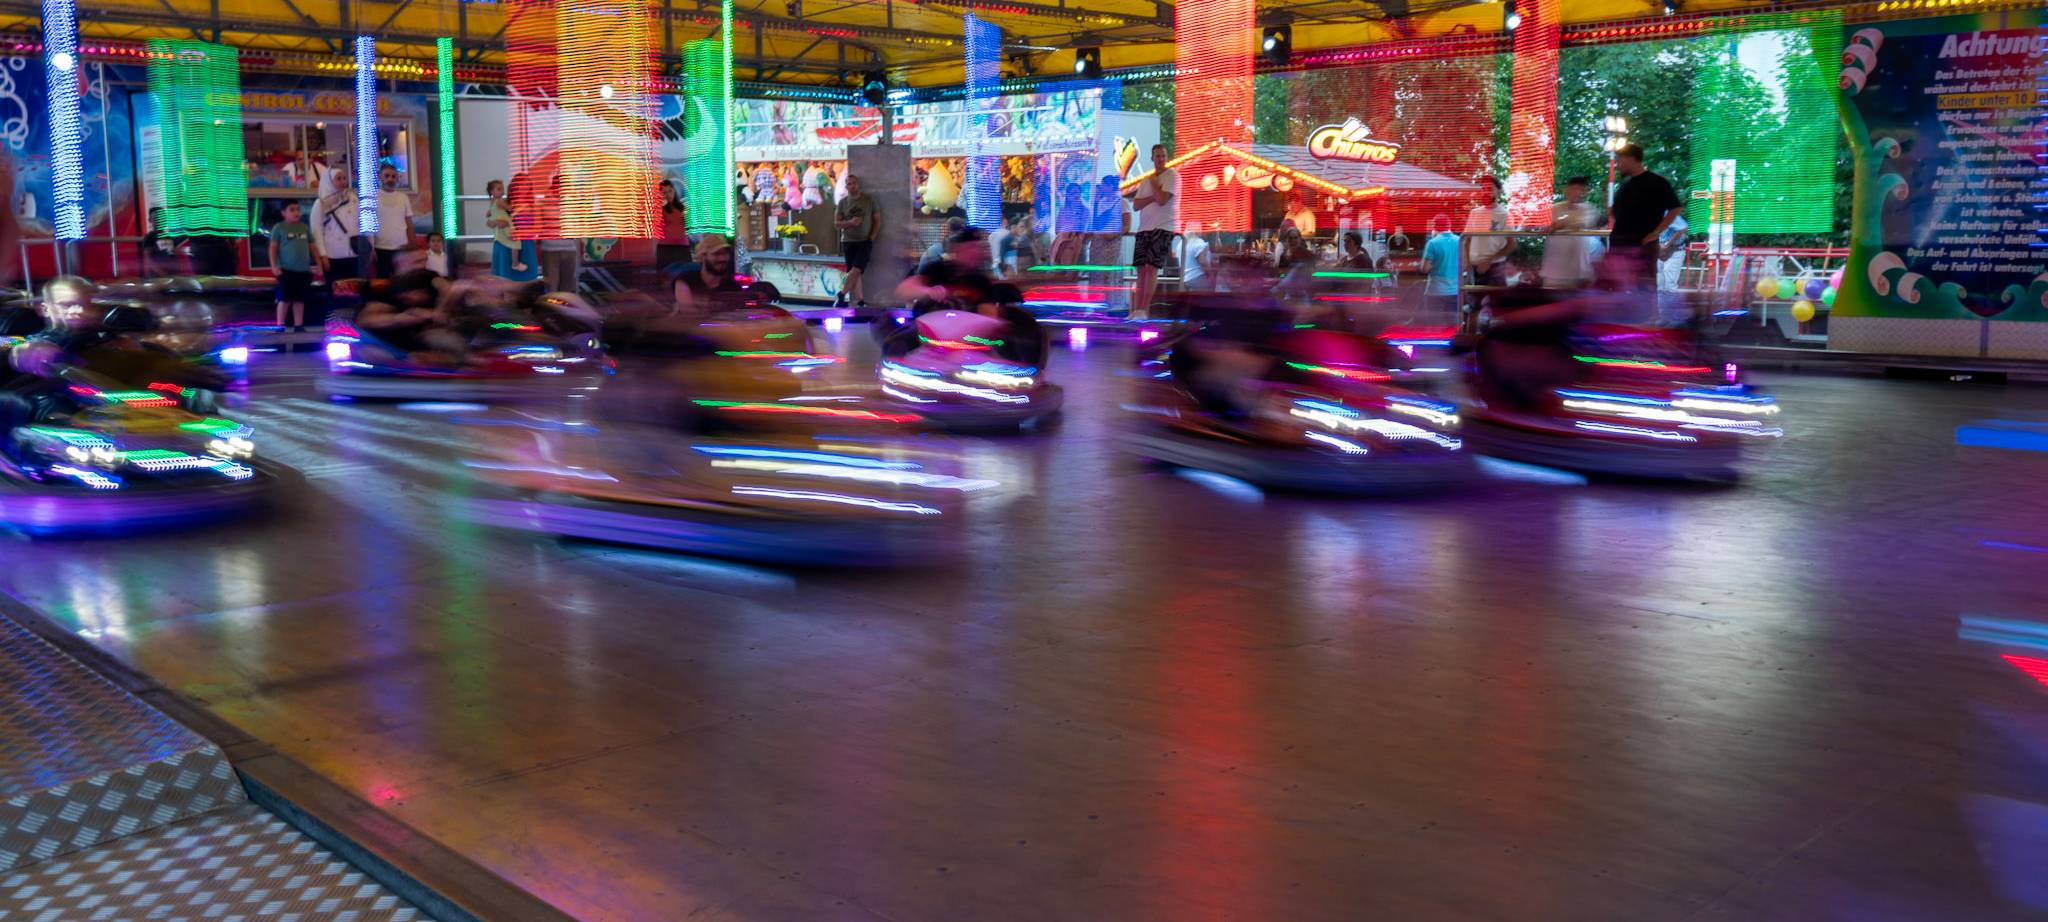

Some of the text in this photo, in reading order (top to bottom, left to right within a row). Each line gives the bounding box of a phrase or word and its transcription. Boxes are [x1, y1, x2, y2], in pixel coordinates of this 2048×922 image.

[1938, 32, 2046, 59] Achtung
[1935, 70, 1954, 80] Das
[1956, 68, 2000, 79] Betreten
[2003, 66, 2021, 77] der
[1924, 83, 1968, 94] während
[1990, 81, 2017, 91] Fahrt
[2019, 80, 2033, 90] ist
[1937, 95, 1977, 107] Kinder
[1980, 95, 2009, 106] unter
[2015, 94, 2027, 105] 10
[1939, 110, 1973, 122] dürfen
[1974, 112, 1993, 120] nur
[1311, 128, 1397, 163] Churros
[1937, 165, 1955, 175] Das
[1960, 206, 2025, 217] ist verboten.
[1930, 221, 1957, 231] Keine
[1960, 220, 2001, 232] Haftung
[2003, 220, 2018, 231] für
[1938, 233, 2002, 244] verschuldete
[1907, 248, 1925, 257] Das
[1926, 247, 1948, 258] Auf-
[1950, 248, 1970, 258] und
[1971, 247, 2029, 260] Abspringen
[1932, 261, 1949, 271] der
[1951, 262, 1978, 272] Fahrt
[1979, 261, 1993, 272] ist
